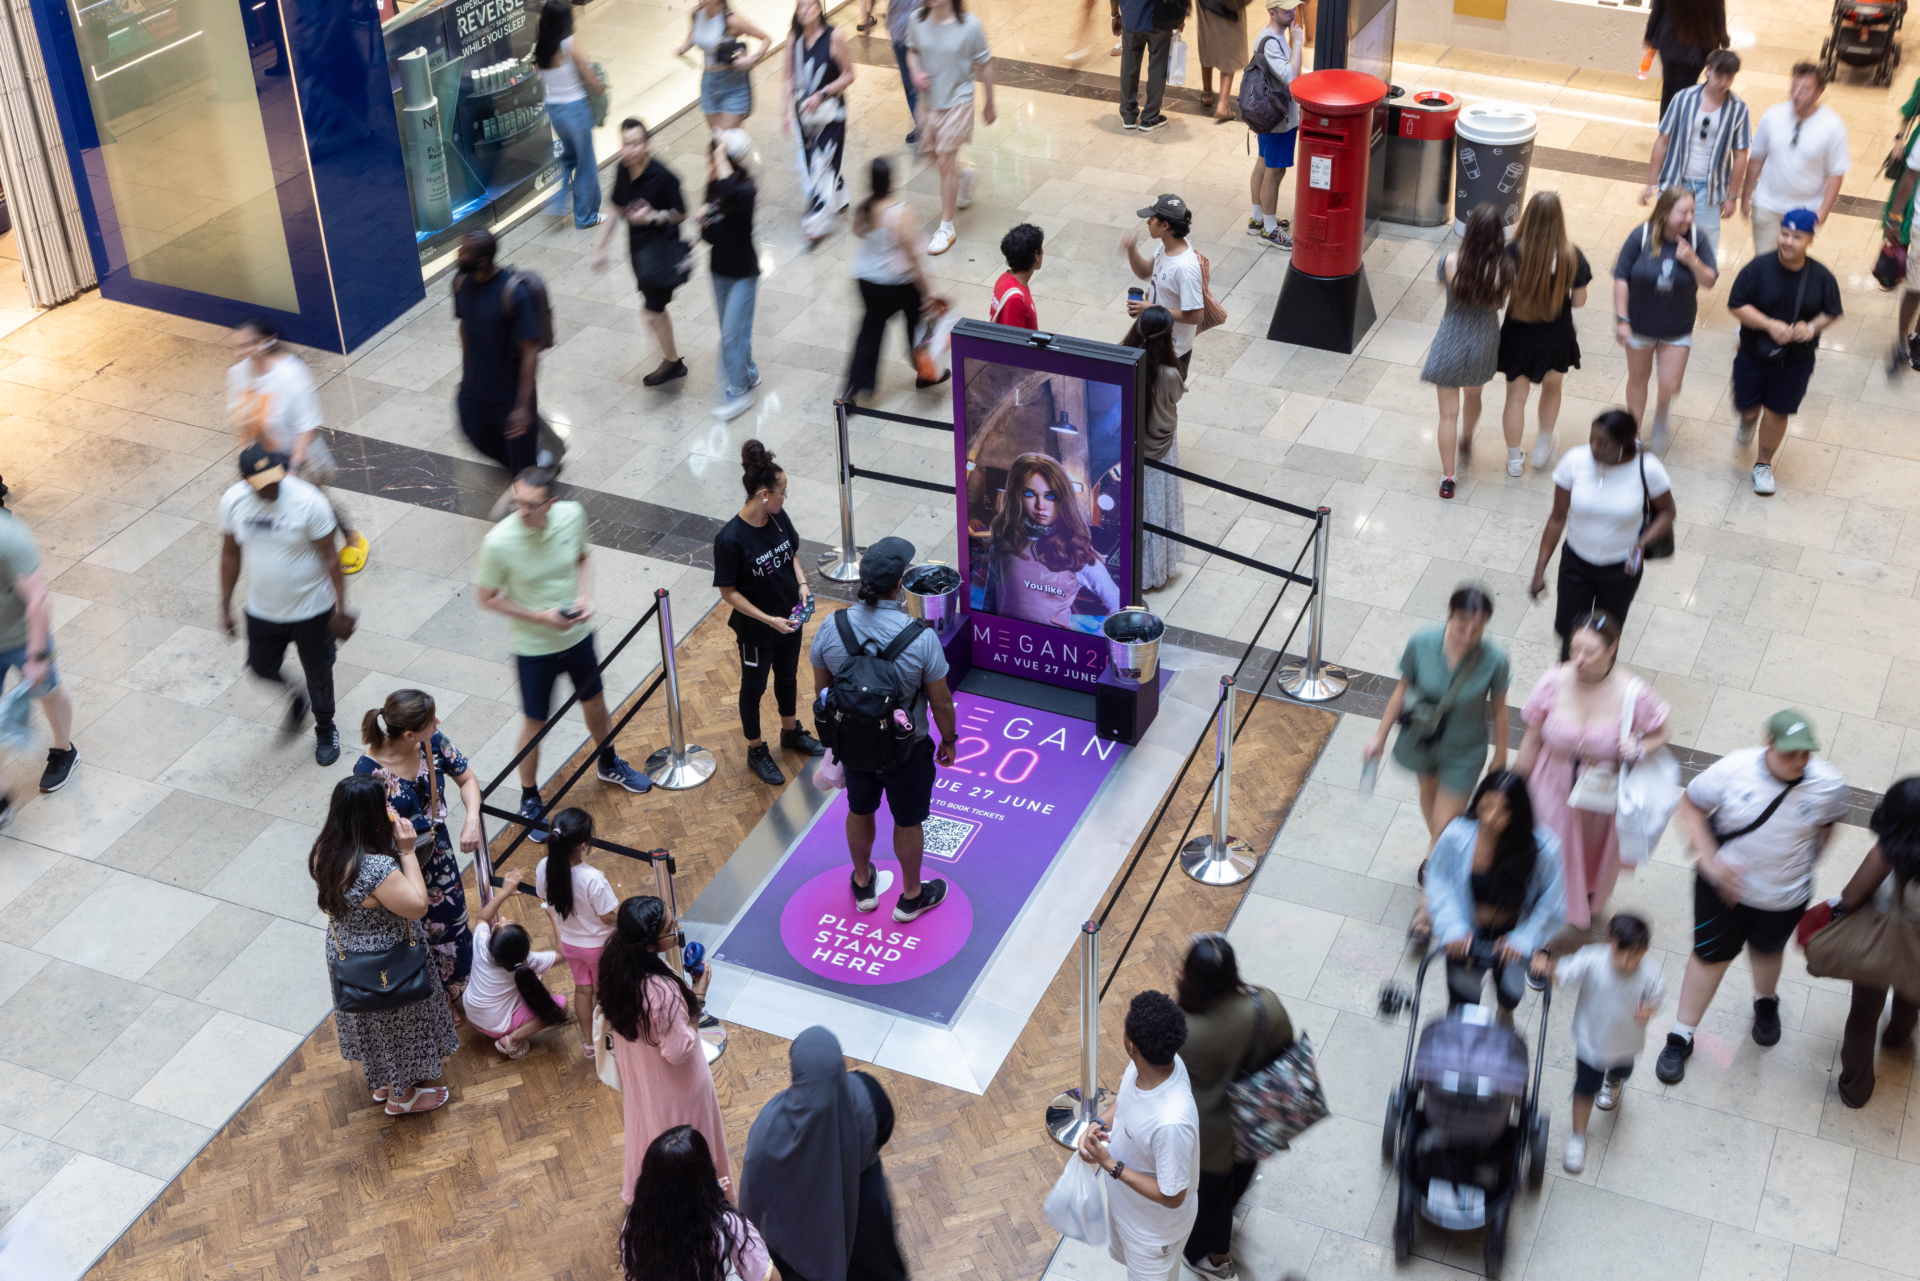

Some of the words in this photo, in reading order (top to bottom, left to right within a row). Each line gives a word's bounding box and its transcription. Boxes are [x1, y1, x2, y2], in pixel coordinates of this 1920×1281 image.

[477, 26, 490, 38] SIGNS
[496, 17, 507, 27] SKIN
[507, 7, 525, 21] DAMAGE
[462, 37, 487, 57] WHILE
[487, 27, 503, 44] YOU
[755, 549, 774, 565] COME
[774, 540, 791, 554] MEET
[1024, 580, 1043, 591] You
[1045, 584, 1066, 597] like,
[993, 652, 1008, 664] AT
[1014, 656, 1039, 671] VUE
[1045, 664, 1059, 675] 27
[1064, 668, 1097, 684] JUNE
[950, 736, 1040, 784] 2.0
[935, 777, 963, 793] UE
[968, 786, 995, 799] 27
[998, 794, 1056, 815] JUNE
[935, 798, 947, 807] TO
[947, 802, 970, 813] BOOK
[971, 807, 1005, 821] TICKETS
[814, 930, 901, 961] STAND
[818, 913, 921, 950] PLEASE
[811, 947, 885, 976] HERE
